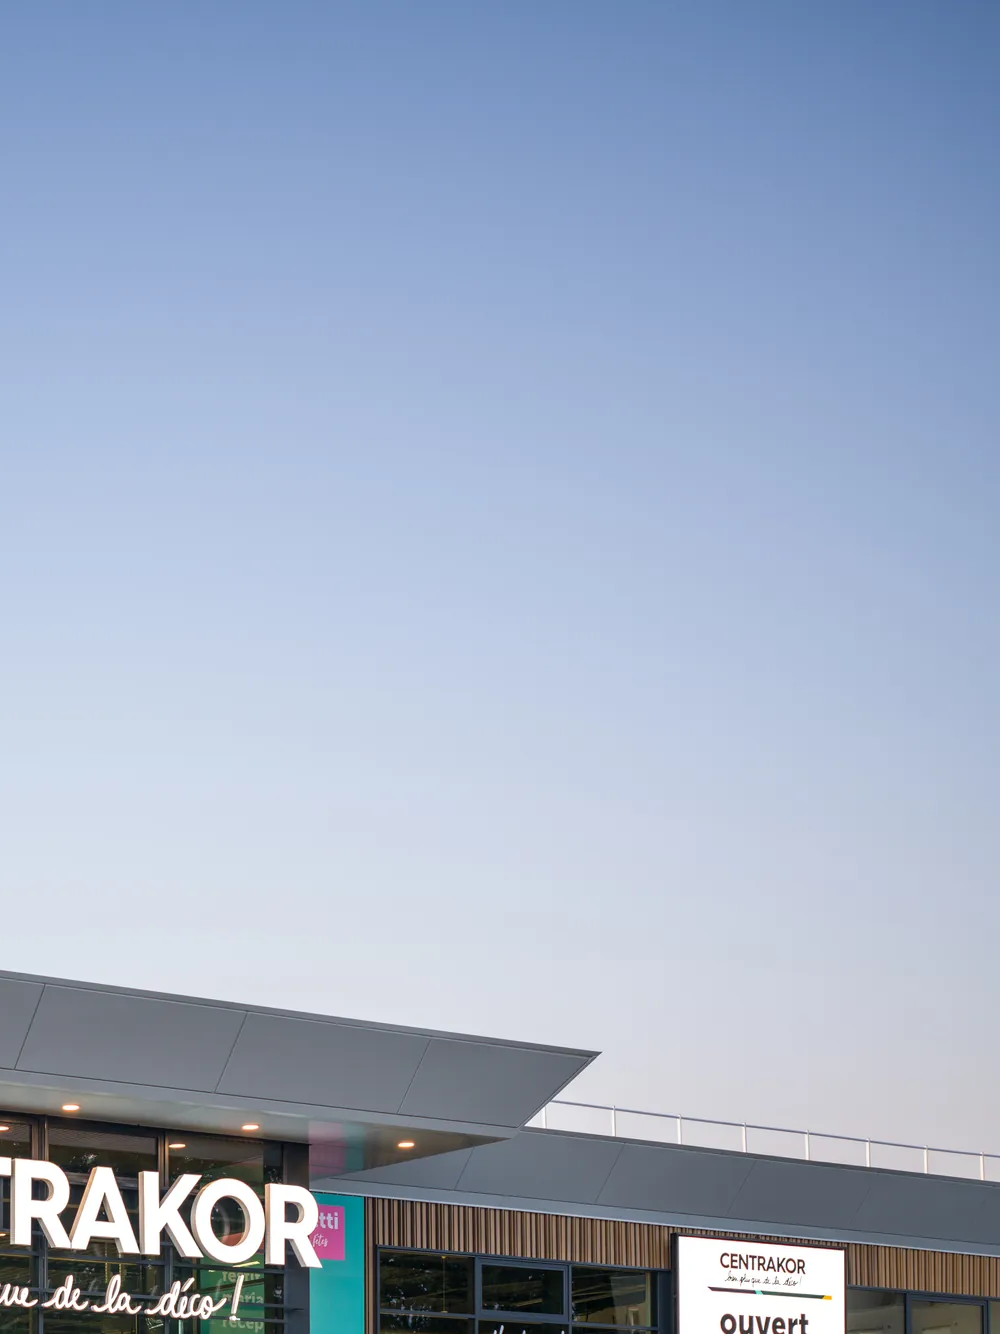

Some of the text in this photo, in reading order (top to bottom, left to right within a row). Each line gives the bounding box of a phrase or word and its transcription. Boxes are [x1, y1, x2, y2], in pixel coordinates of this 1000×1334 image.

[720, 1252, 806, 1275] CENTRAKOR
[41, 1275, 89, 1310] de
[91, 1274, 142, 1314] la
[144, 1277, 227, 1320] déco
